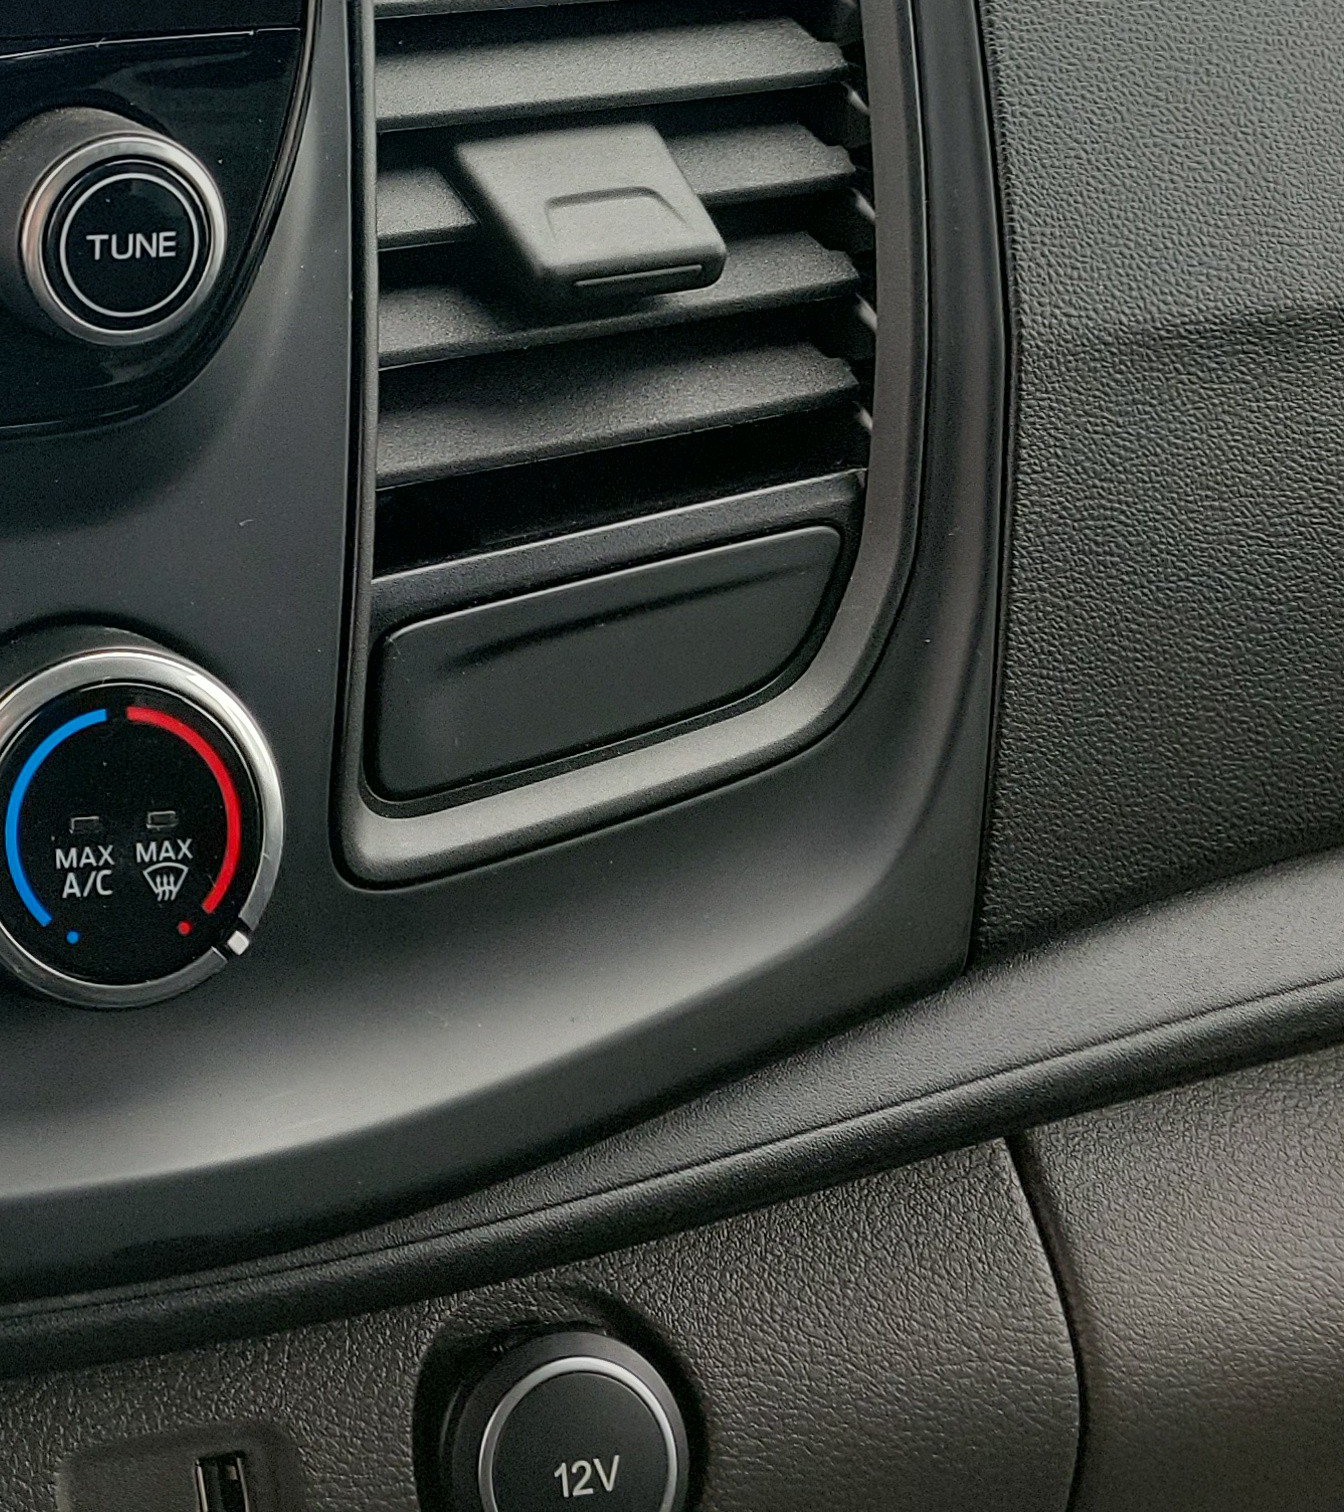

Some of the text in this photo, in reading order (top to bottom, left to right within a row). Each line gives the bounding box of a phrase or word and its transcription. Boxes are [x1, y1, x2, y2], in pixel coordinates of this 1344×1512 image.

[85, 230, 177, 262] TUNE
[54, 844, 116, 871] MAX
[134, 837, 194, 863] MAX
[61, 867, 114, 900] A/C
[553, 1453, 620, 1498] 12V
